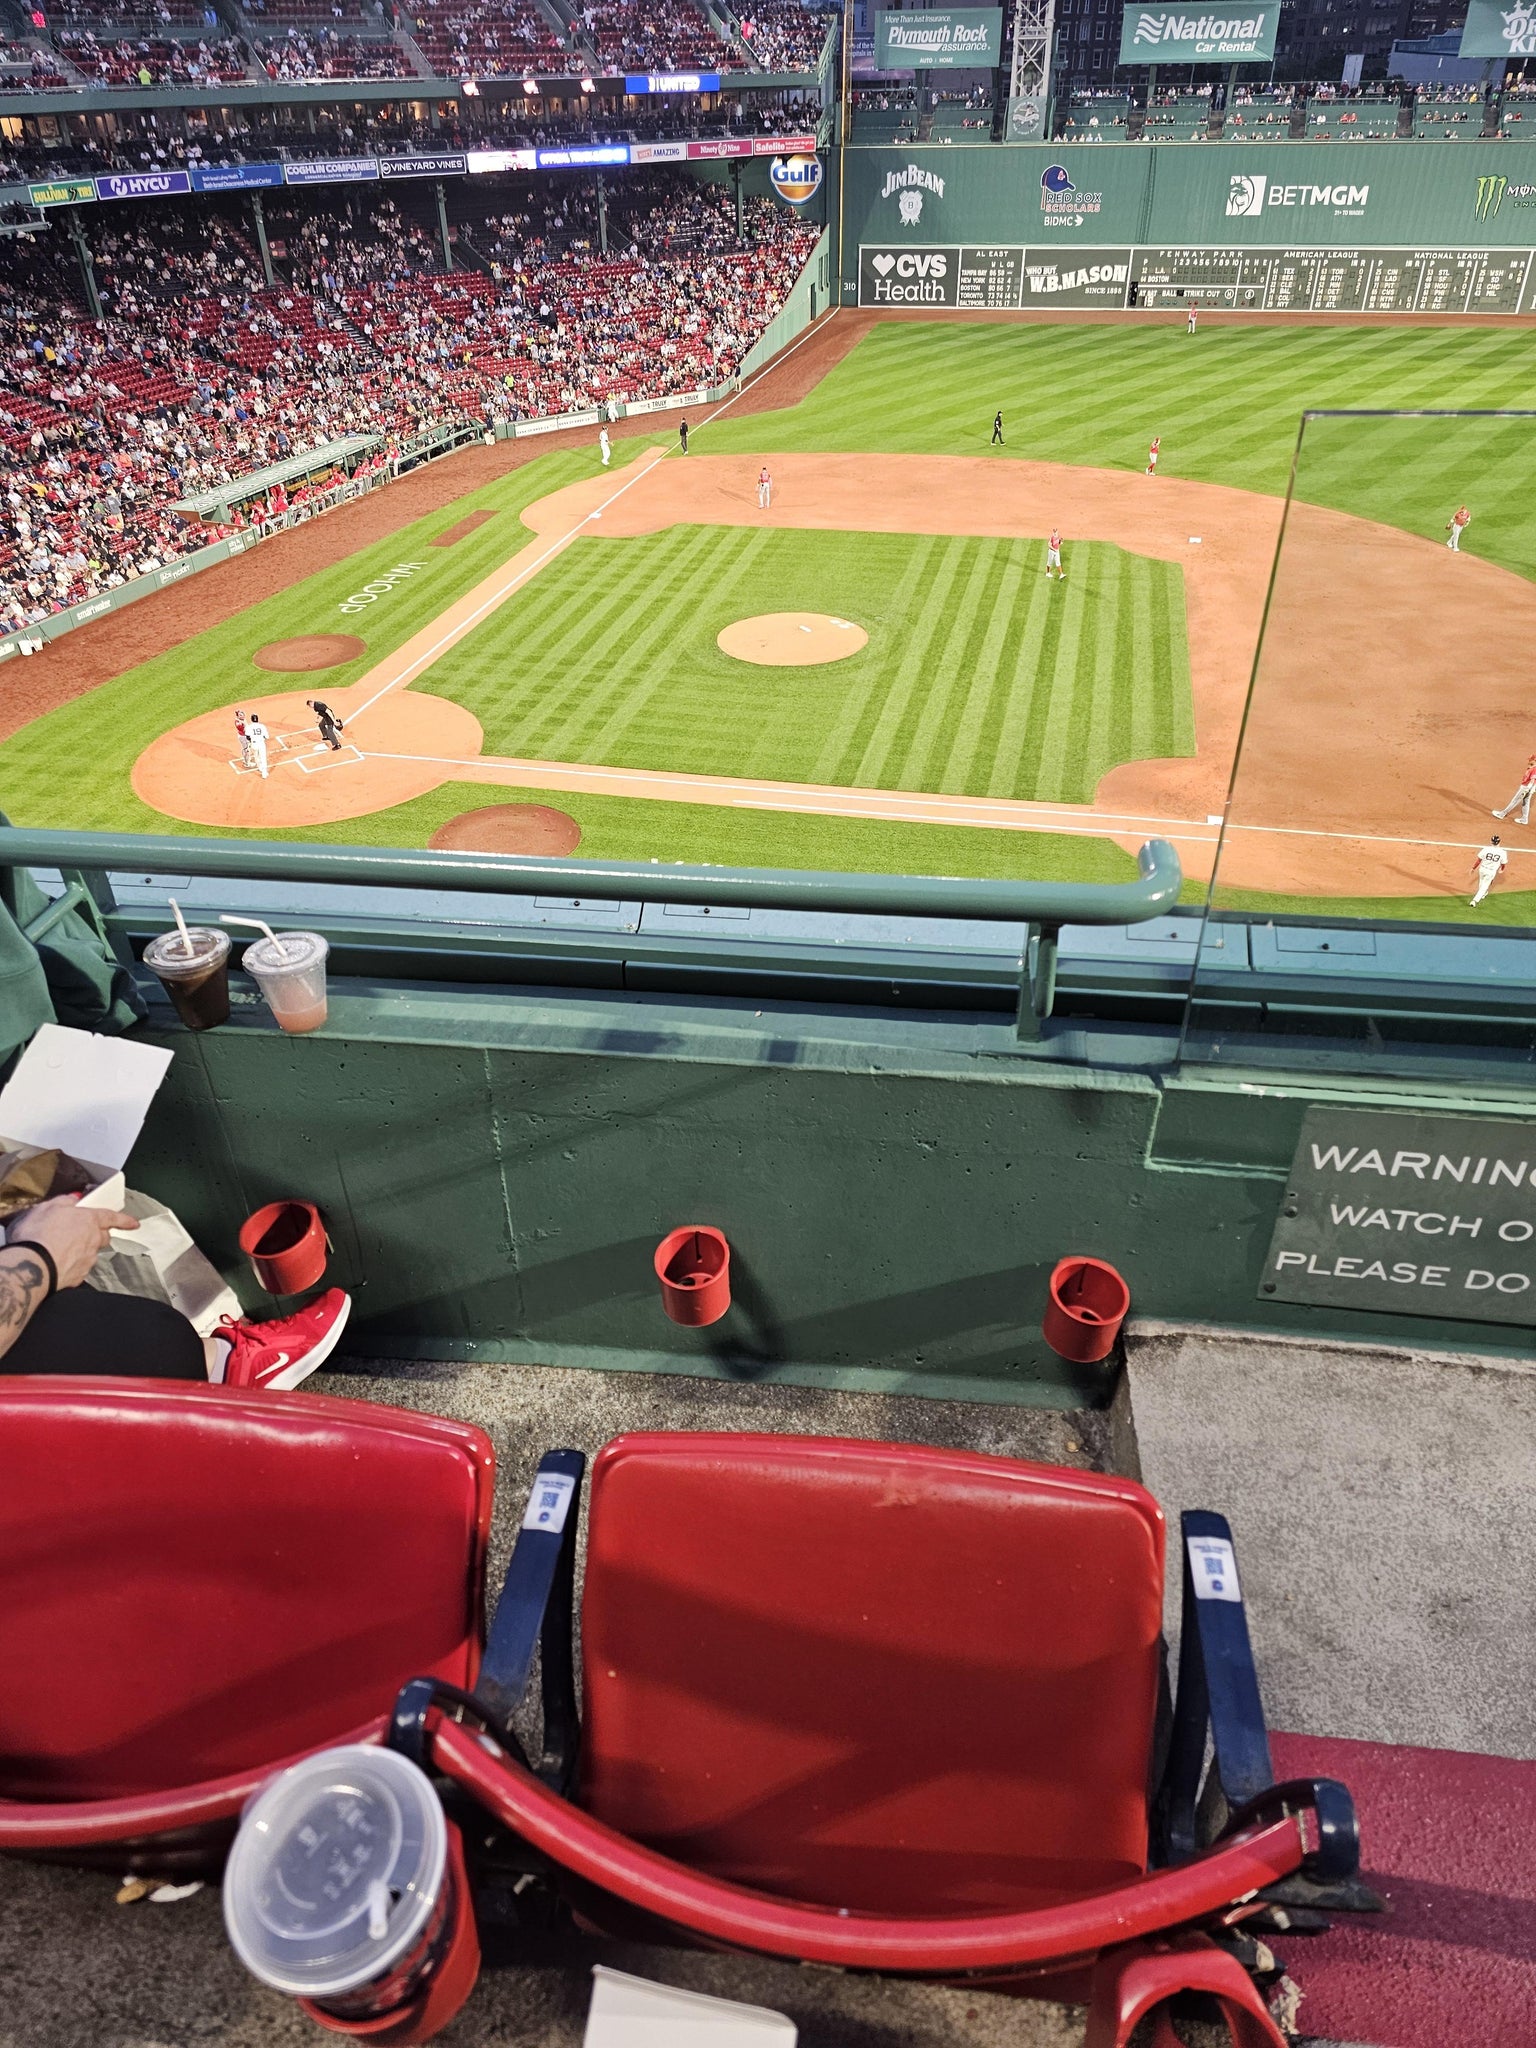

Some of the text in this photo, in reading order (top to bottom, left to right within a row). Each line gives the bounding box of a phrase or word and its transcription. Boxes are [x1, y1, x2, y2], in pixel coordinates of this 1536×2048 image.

[888, 24, 988, 44] Plymouth Rock
[1162, 14, 1264, 40] National
[942, 42, 986, 52] assurance
[1195, 41, 1256, 52] Car Rental
[756, 142, 785, 152] Safelite
[287, 162, 376, 175] COGHLIN COMPANIES
[391, 162, 436, 172] VINEYARD
[437, 160, 462, 169] VINES
[772, 164, 818, 182] Gulf
[130, 178, 167, 192] HYCU
[882, 164, 945, 198] JIM BEAM
[34, 187, 68, 202] SULLIVAN
[1046, 193, 1102, 203] RED SOX
[1268, 186, 1369, 205] BETMGM
[1045, 204, 1100, 213] SCHOLARS
[1044, 216, 1073, 226] BIDMC
[896, 254, 947, 278] CVS
[1026, 267, 1042, 275] WHO
[844, 282, 856, 291] 310
[874, 279, 945, 301] Health
[338, 562, 428, 613] WHOOP
[1311, 1144, 1536, 1188] WARNIN
[1330, 1203, 1482, 1238] WATCH
[1275, 1251, 1530, 1293] PLEASE DO
